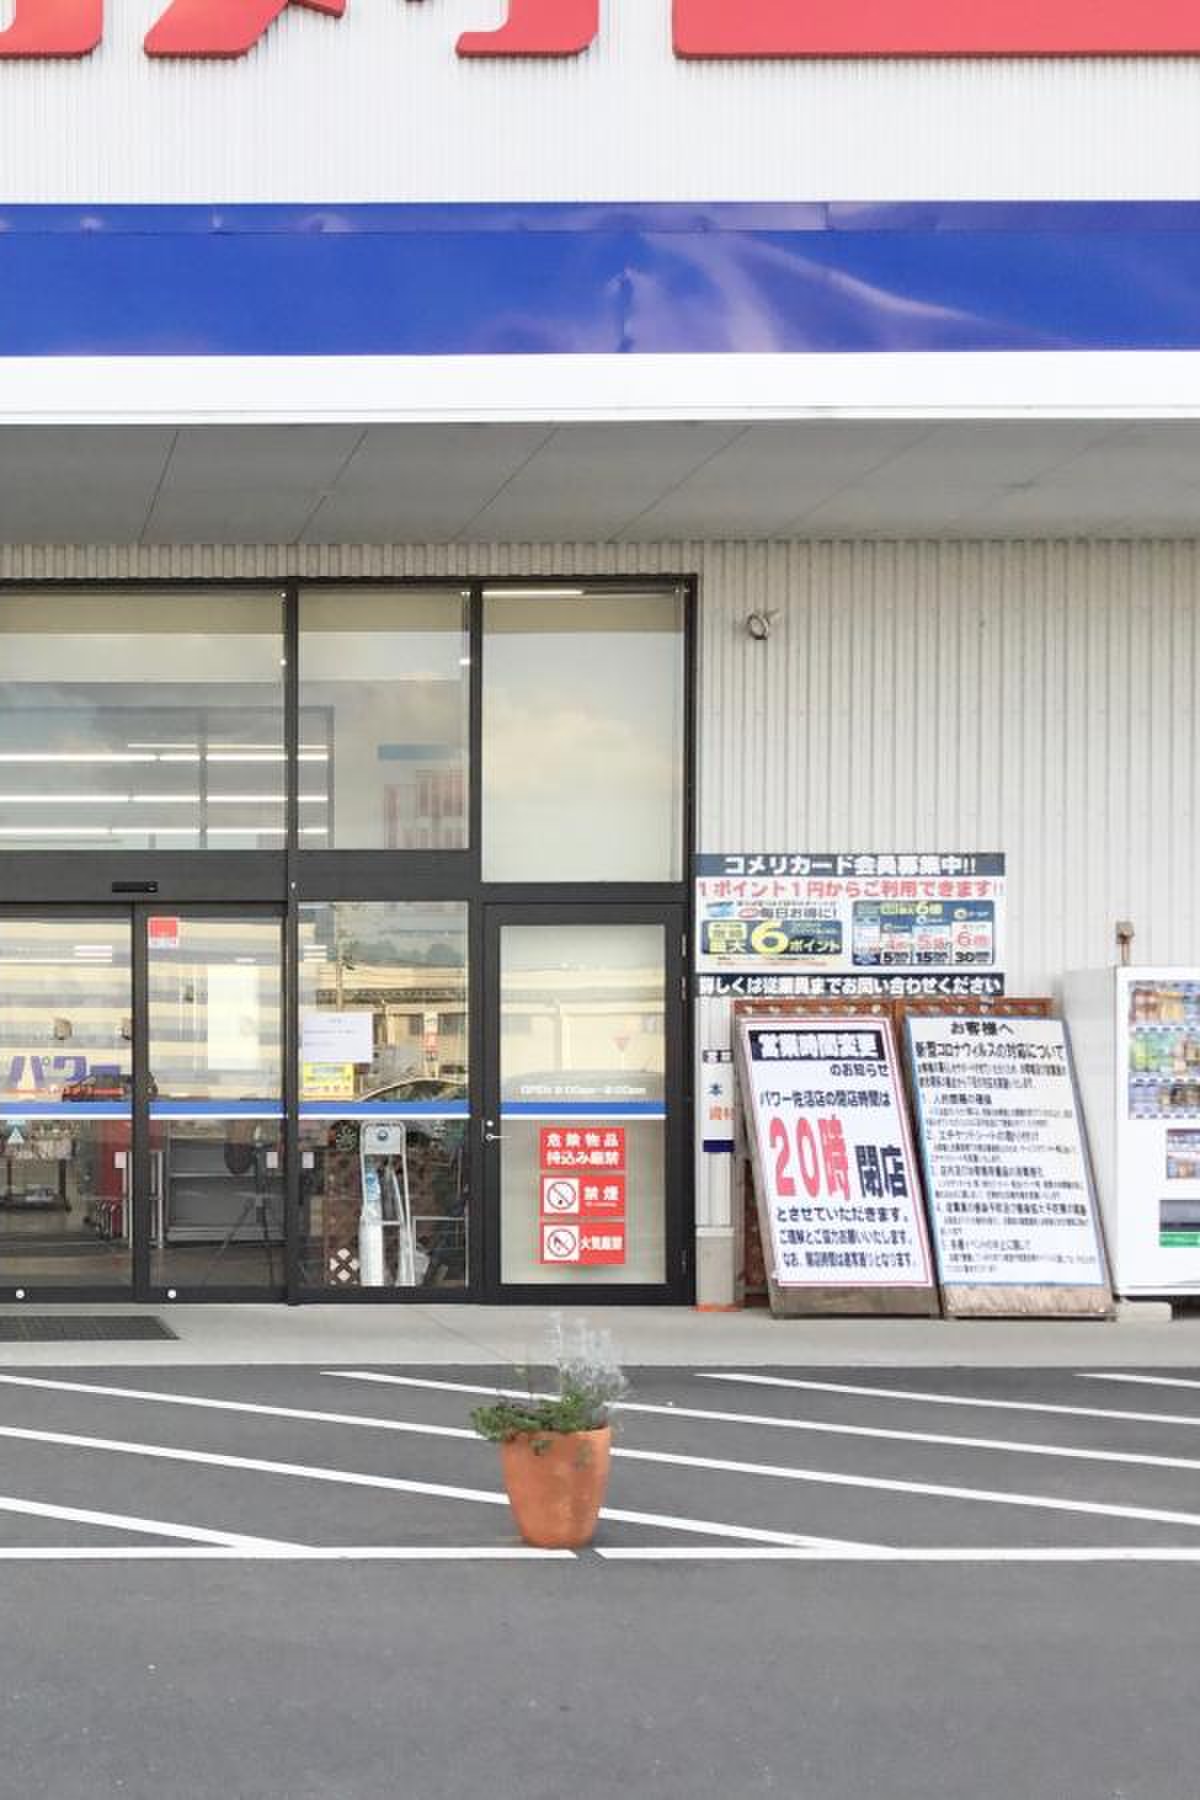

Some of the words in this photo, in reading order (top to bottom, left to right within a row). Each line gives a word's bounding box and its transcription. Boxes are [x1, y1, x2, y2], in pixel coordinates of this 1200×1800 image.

[751, 920, 788, 954] 6
[830, 1063, 889, 1077] のお知らせ
[769, 1114, 851, 1200] 20時
[855, 1144, 908, 1198] 閉店
[777, 1206, 908, 1223] とさせていただきます。
